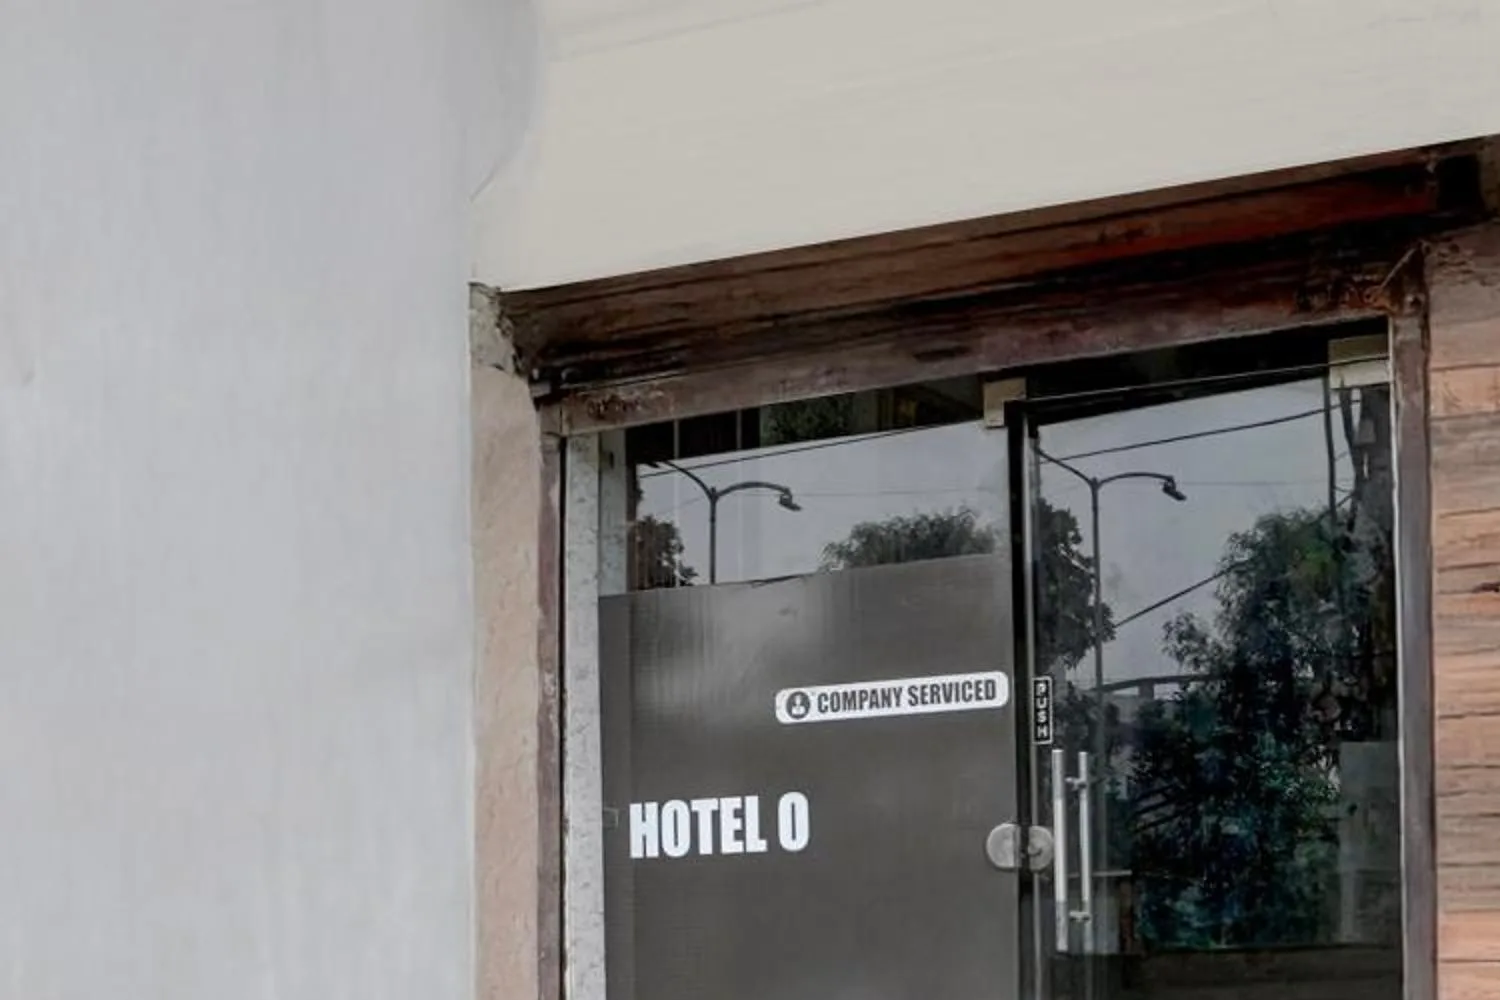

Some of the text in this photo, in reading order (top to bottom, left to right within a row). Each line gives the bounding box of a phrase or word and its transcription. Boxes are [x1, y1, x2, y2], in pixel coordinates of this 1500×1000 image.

[817, 679, 996, 714] COMPANY SERVICED
[1036, 682, 1049, 738] PUSH
[629, 791, 810, 860] HOTEL O
